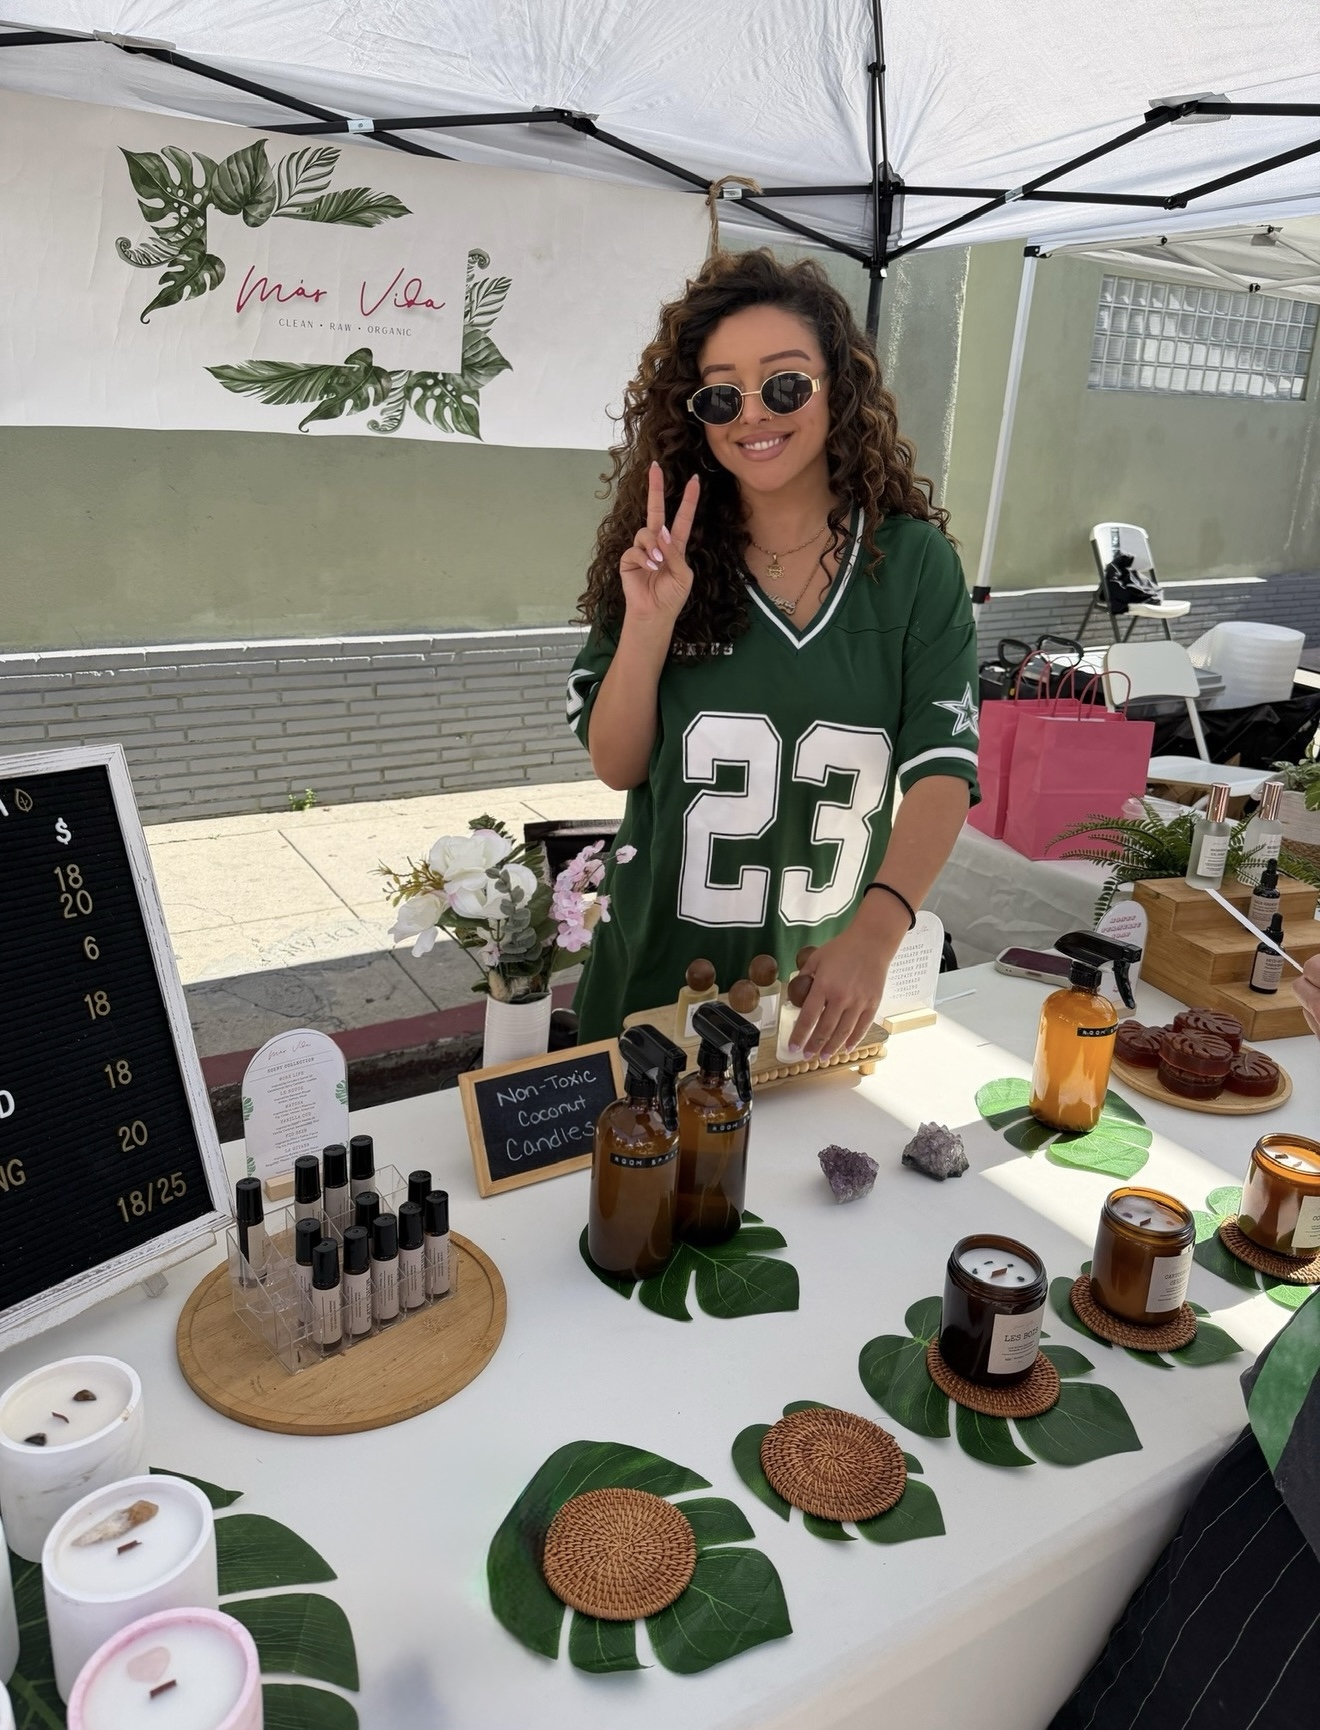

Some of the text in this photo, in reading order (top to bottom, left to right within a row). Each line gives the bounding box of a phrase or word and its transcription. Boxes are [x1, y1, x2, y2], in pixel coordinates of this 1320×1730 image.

[360, 267, 446, 317] Vida
[278, 318, 413, 337] CLEAN RAW ORGANIC
[54, 817, 72, 845] $
[676, 710, 893, 929] 23
[53, 863, 83, 892] 18
[60, 889, 93, 919] 20
[83, 937, 101, 961] 6
[84, 991, 111, 1020] 18
[104, 1060, 134, 1091] 18
[284, 1057, 315, 1069] COLLECTION
[496, 1068, 597, 1108] Non-Toxic
[517, 1095, 587, 1127] Coconut
[118, 1120, 149, 1152] 20
[506, 1120, 596, 1162] Candles
[712, 1122, 738, 1132] ROOM
[614, 1156, 643, 1166] ROOM
[116, 1172, 188, 1224] 18/25
[1004, 1326, 1039, 1343] LES BOIS
